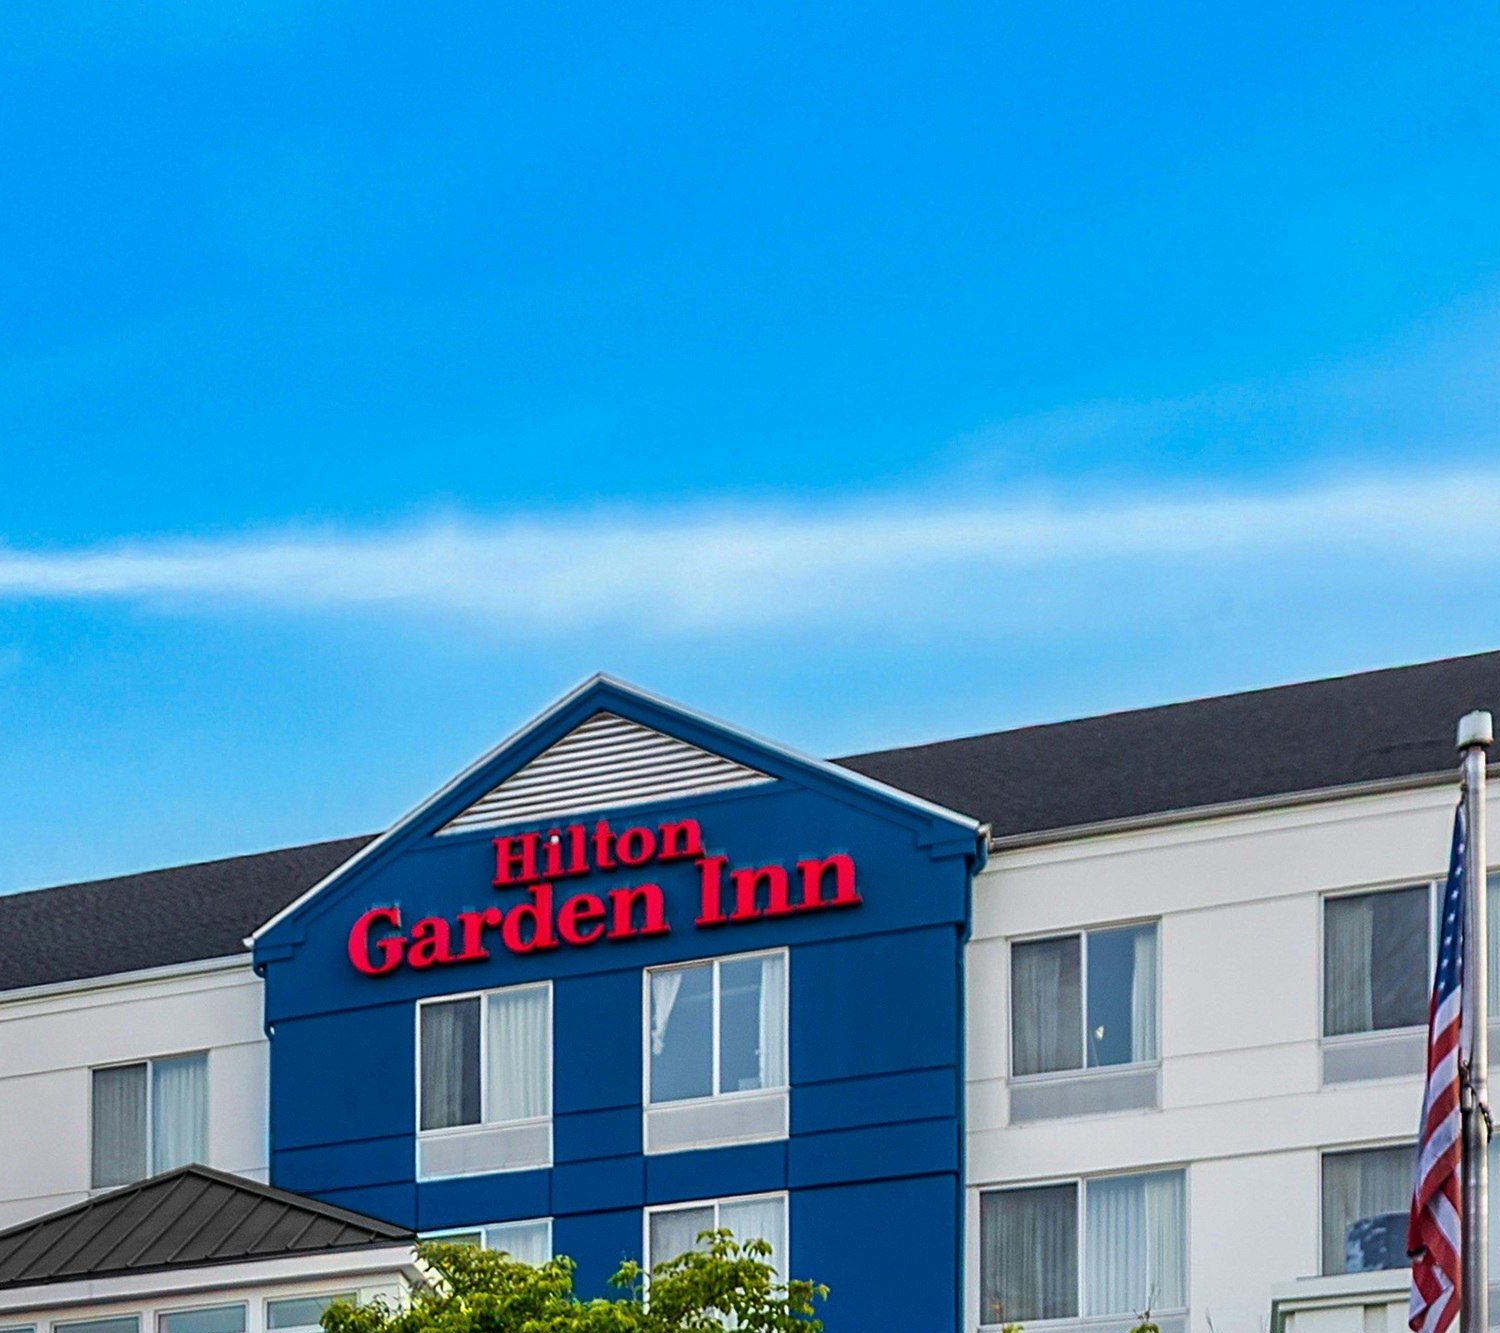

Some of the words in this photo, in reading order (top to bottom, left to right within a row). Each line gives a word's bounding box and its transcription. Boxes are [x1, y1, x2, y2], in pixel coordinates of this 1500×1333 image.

[493, 818, 703, 885] Hilton
[347, 883, 670, 977] Garden
[694, 853, 862, 927] Inn
